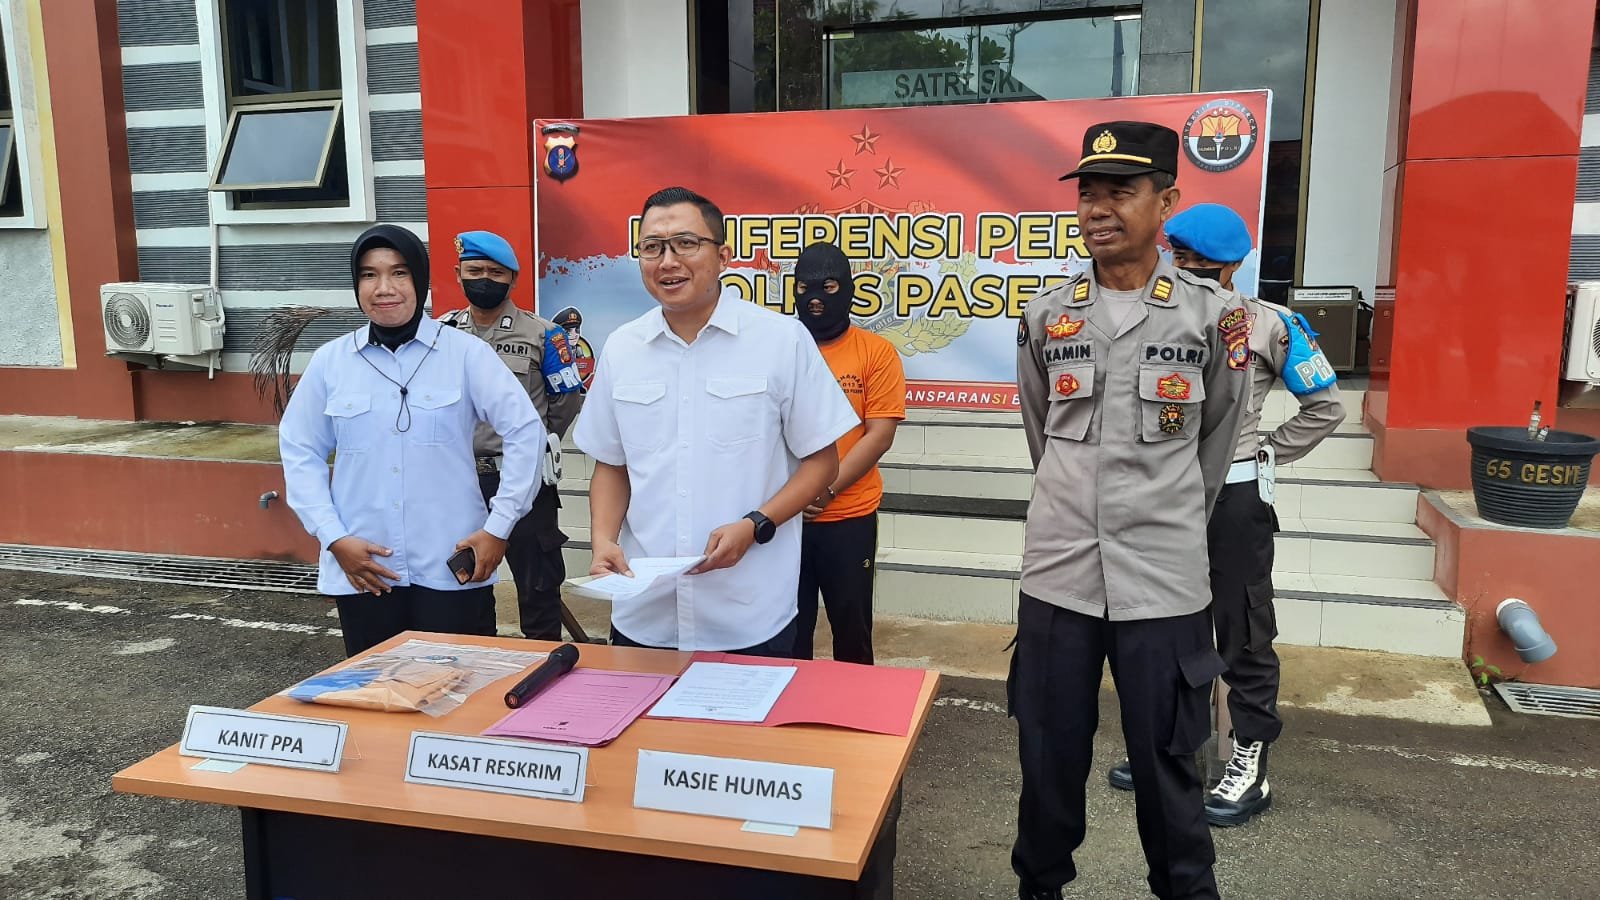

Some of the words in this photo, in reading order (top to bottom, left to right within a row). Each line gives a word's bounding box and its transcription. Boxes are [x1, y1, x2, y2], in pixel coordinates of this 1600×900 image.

[894, 69, 1024, 98] SATRESK
[978, 214, 1092, 259] PER
[496, 343, 528, 355] POLRI
[1045, 344, 1091, 363] KAMIN
[1146, 346, 1204, 364] POLRI
[905, 390, 1008, 405] ANSPARANSI
[1486, 459, 1512, 479] 65
[218, 729, 269, 749] KANIT
[271, 735, 303, 754] PPA
[428, 752, 482, 773] KASAT
[485, 758, 562, 782] RESKRIM
[663, 768, 719, 792] KASIE
[725, 775, 803, 801] HUMAS
